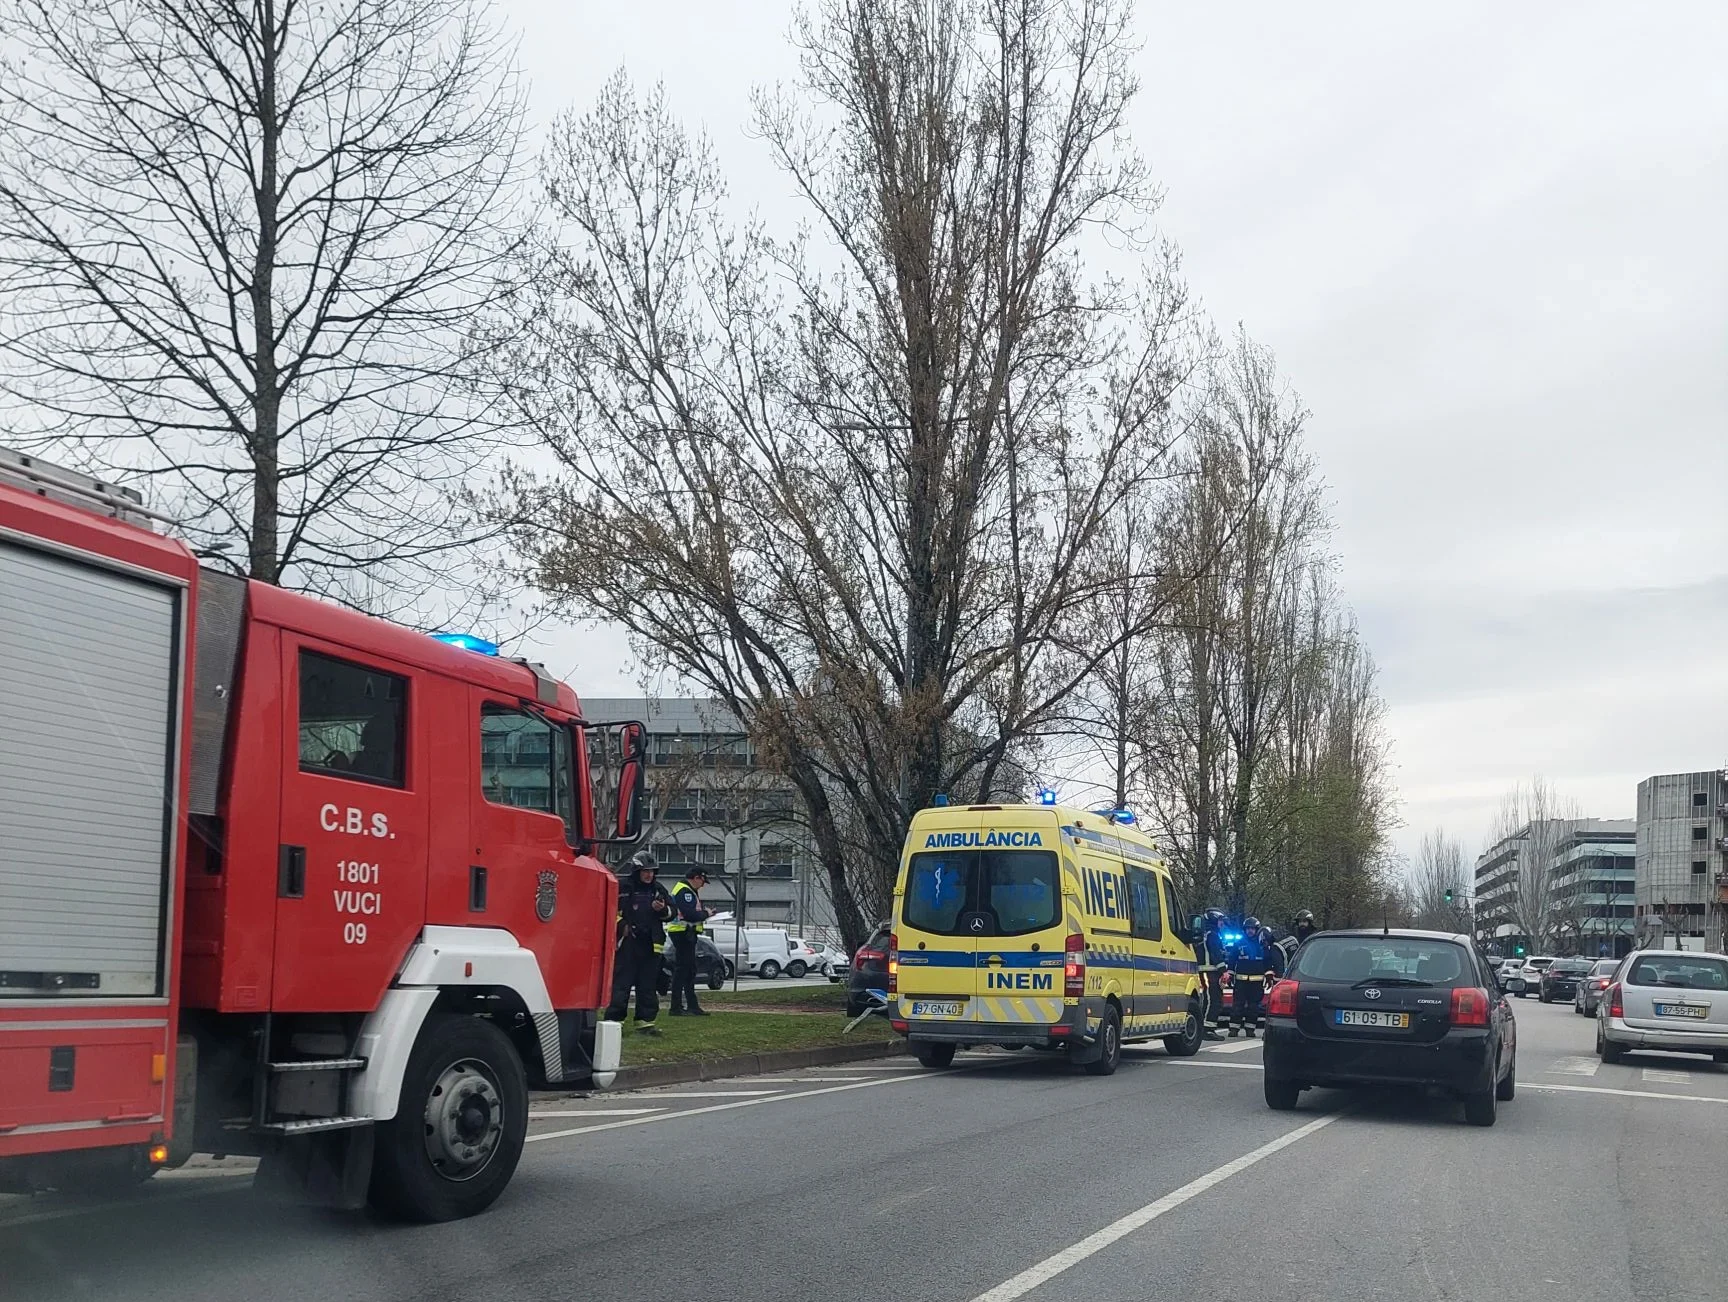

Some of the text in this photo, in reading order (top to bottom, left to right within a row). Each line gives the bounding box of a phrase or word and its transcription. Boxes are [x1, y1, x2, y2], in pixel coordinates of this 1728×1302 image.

[320, 803, 396, 839] C.B.S.
[925, 828, 1043, 848] AMBULÂNCIA
[337, 860, 379, 884] 1801
[333, 890, 381, 915] VUCI
[1081, 866, 1129, 920] INEM
[344, 922, 367, 944] 09
[987, 972, 1053, 990] INEM
